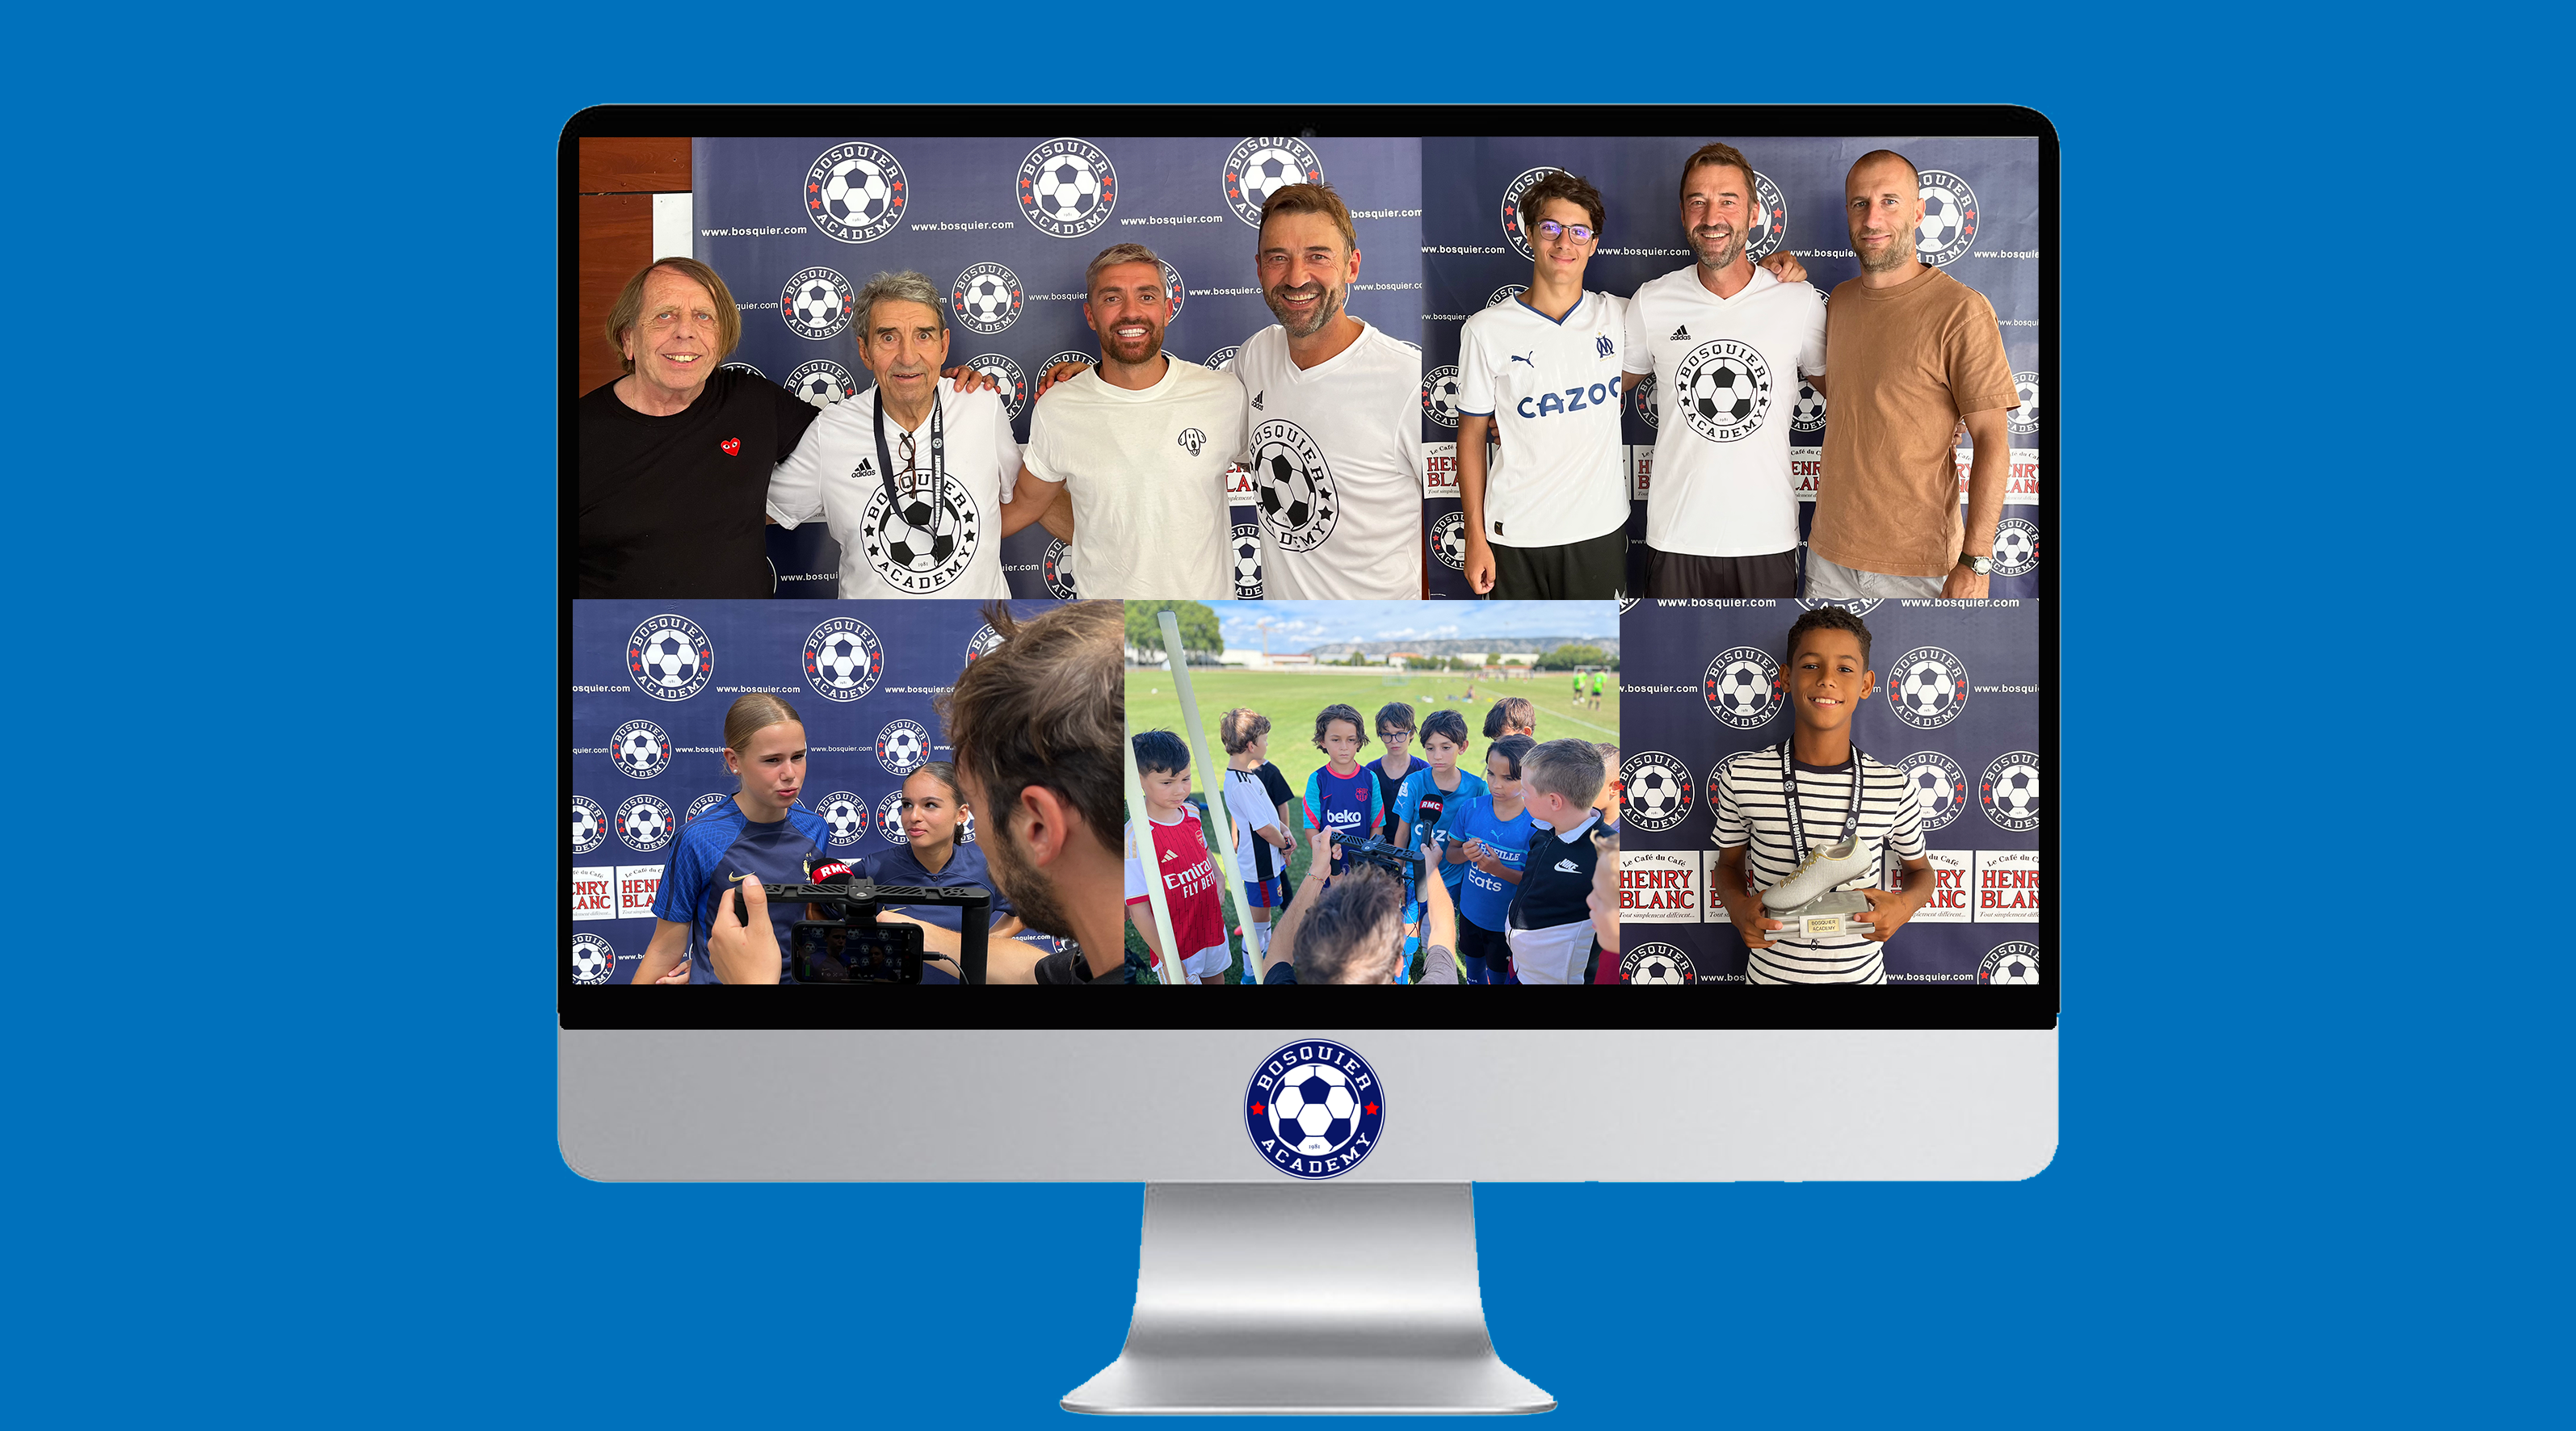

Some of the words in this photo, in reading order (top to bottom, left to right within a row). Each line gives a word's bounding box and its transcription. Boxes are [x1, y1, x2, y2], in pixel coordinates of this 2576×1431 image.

[812, 146, 898, 180] BOSQUIER
[1023, 141, 1108, 176] BOSQUIER
[1229, 137, 1313, 170] BOSQUIER
[1918, 174, 1972, 208] QUIER
[817, 208, 898, 240] ACADEMY
[1029, 203, 1108, 234] ACADEMY
[1120, 215, 1222, 226] www.bosquier.com
[1350, 208, 1422, 220] .bosquier.com
[701, 225, 807, 237] www.bosquier.com
[911, 220, 1014, 232] www.bosquier.com
[1422, 245, 1505, 255] ww.bosquier.com
[1597, 246, 1690, 258] www.bosquier.com
[1916, 235, 1969, 263] ADEMY
[787, 269, 847, 295] BOSQUIER
[956, 266, 1017, 290] BOSQUIER
[1028, 292, 1088, 301] www.bosquier
[789, 314, 848, 338] ACADEMY
[960, 308, 1018, 332] ACADEMY
[969, 356, 1021, 380] SQUIER
[1680, 344, 1766, 379] BOSQUIER
[788, 362, 851, 389] BOSQUIER
[1688, 410, 1763, 439] ACADEMY
[1250, 425, 1325, 483] BOSQUIER
[1430, 447, 1438, 455] Le
[851, 469, 876, 478] adidas
[1996, 521, 2039, 541] SQUIER
[877, 545, 971, 590] ACADEMY
[1992, 557, 2036, 574] CADEMY
[780, 572, 838, 581] www.bosqui
[1657, 598, 1776, 610] www.bosquier.com
[1901, 598, 2019, 610] www.bosquier.com
[633, 618, 705, 648] BOSQUIER
[808, 620, 877, 650] BOSQUIER
[1709, 649, 1778, 678] BOSQUIER
[1893, 649, 1963, 678] BOSQUIER
[573, 685, 630, 694] osquier.com
[638, 672, 706, 699] ACADEMY
[716, 685, 800, 695] www.bosquier.com
[812, 674, 876, 699] ACADEMY
[1712, 702, 1777, 727] ACADEMY
[1896, 701, 1960, 727] ACADEMY
[615, 722, 666, 742] BOSQUIER
[880, 721, 927, 741] BOSQUIER
[618, 758, 666, 777] ACADEMY
[1620, 754, 1687, 782] BOSQUIER
[1900, 754, 1960, 781] OSQUIER
[620, 796, 670, 816] BOSQUIER
[690, 795, 722, 816] BOSQU
[818, 793, 864, 812] BOSQUIER
[1422, 801, 1440, 810] RMC
[1788, 797, 1798, 824] BOSQUIER
[1327, 809, 1361, 824] beko
[1624, 804, 1687, 829] ACADEMY
[1923, 804, 1959, 829] DEMY
[623, 832, 670, 850] ACADEMY
[1792, 824, 1804, 851] FOOTBALL
[820, 864, 851, 878] RMC
[1559, 858, 1578, 871] NIKE
[1622, 860, 1633, 868] Le
[1634, 854, 1654, 862] Café
[1667, 855, 1687, 867] Café
[1940, 855, 1960, 867] Café
[1987, 859, 1997, 867] Le
[1998, 854, 2018, 862] Café
[1183, 881, 1198, 898] FLY
[1469, 868, 1502, 892] Eats
[1620, 870, 1693, 890] HENRY
[1981, 870, 2039, 888] HENR
[1620, 890, 1694, 909] BLANC
[1981, 890, 2039, 909] BLAN
[1624, 945, 1690, 971] BOSQUIER
[1887, 973, 1973, 983] ww.bosquier.com
[1257, 1046, 1372, 1091] BOSQUIER
[1261, 1132, 1372, 1173] ACADEMY
